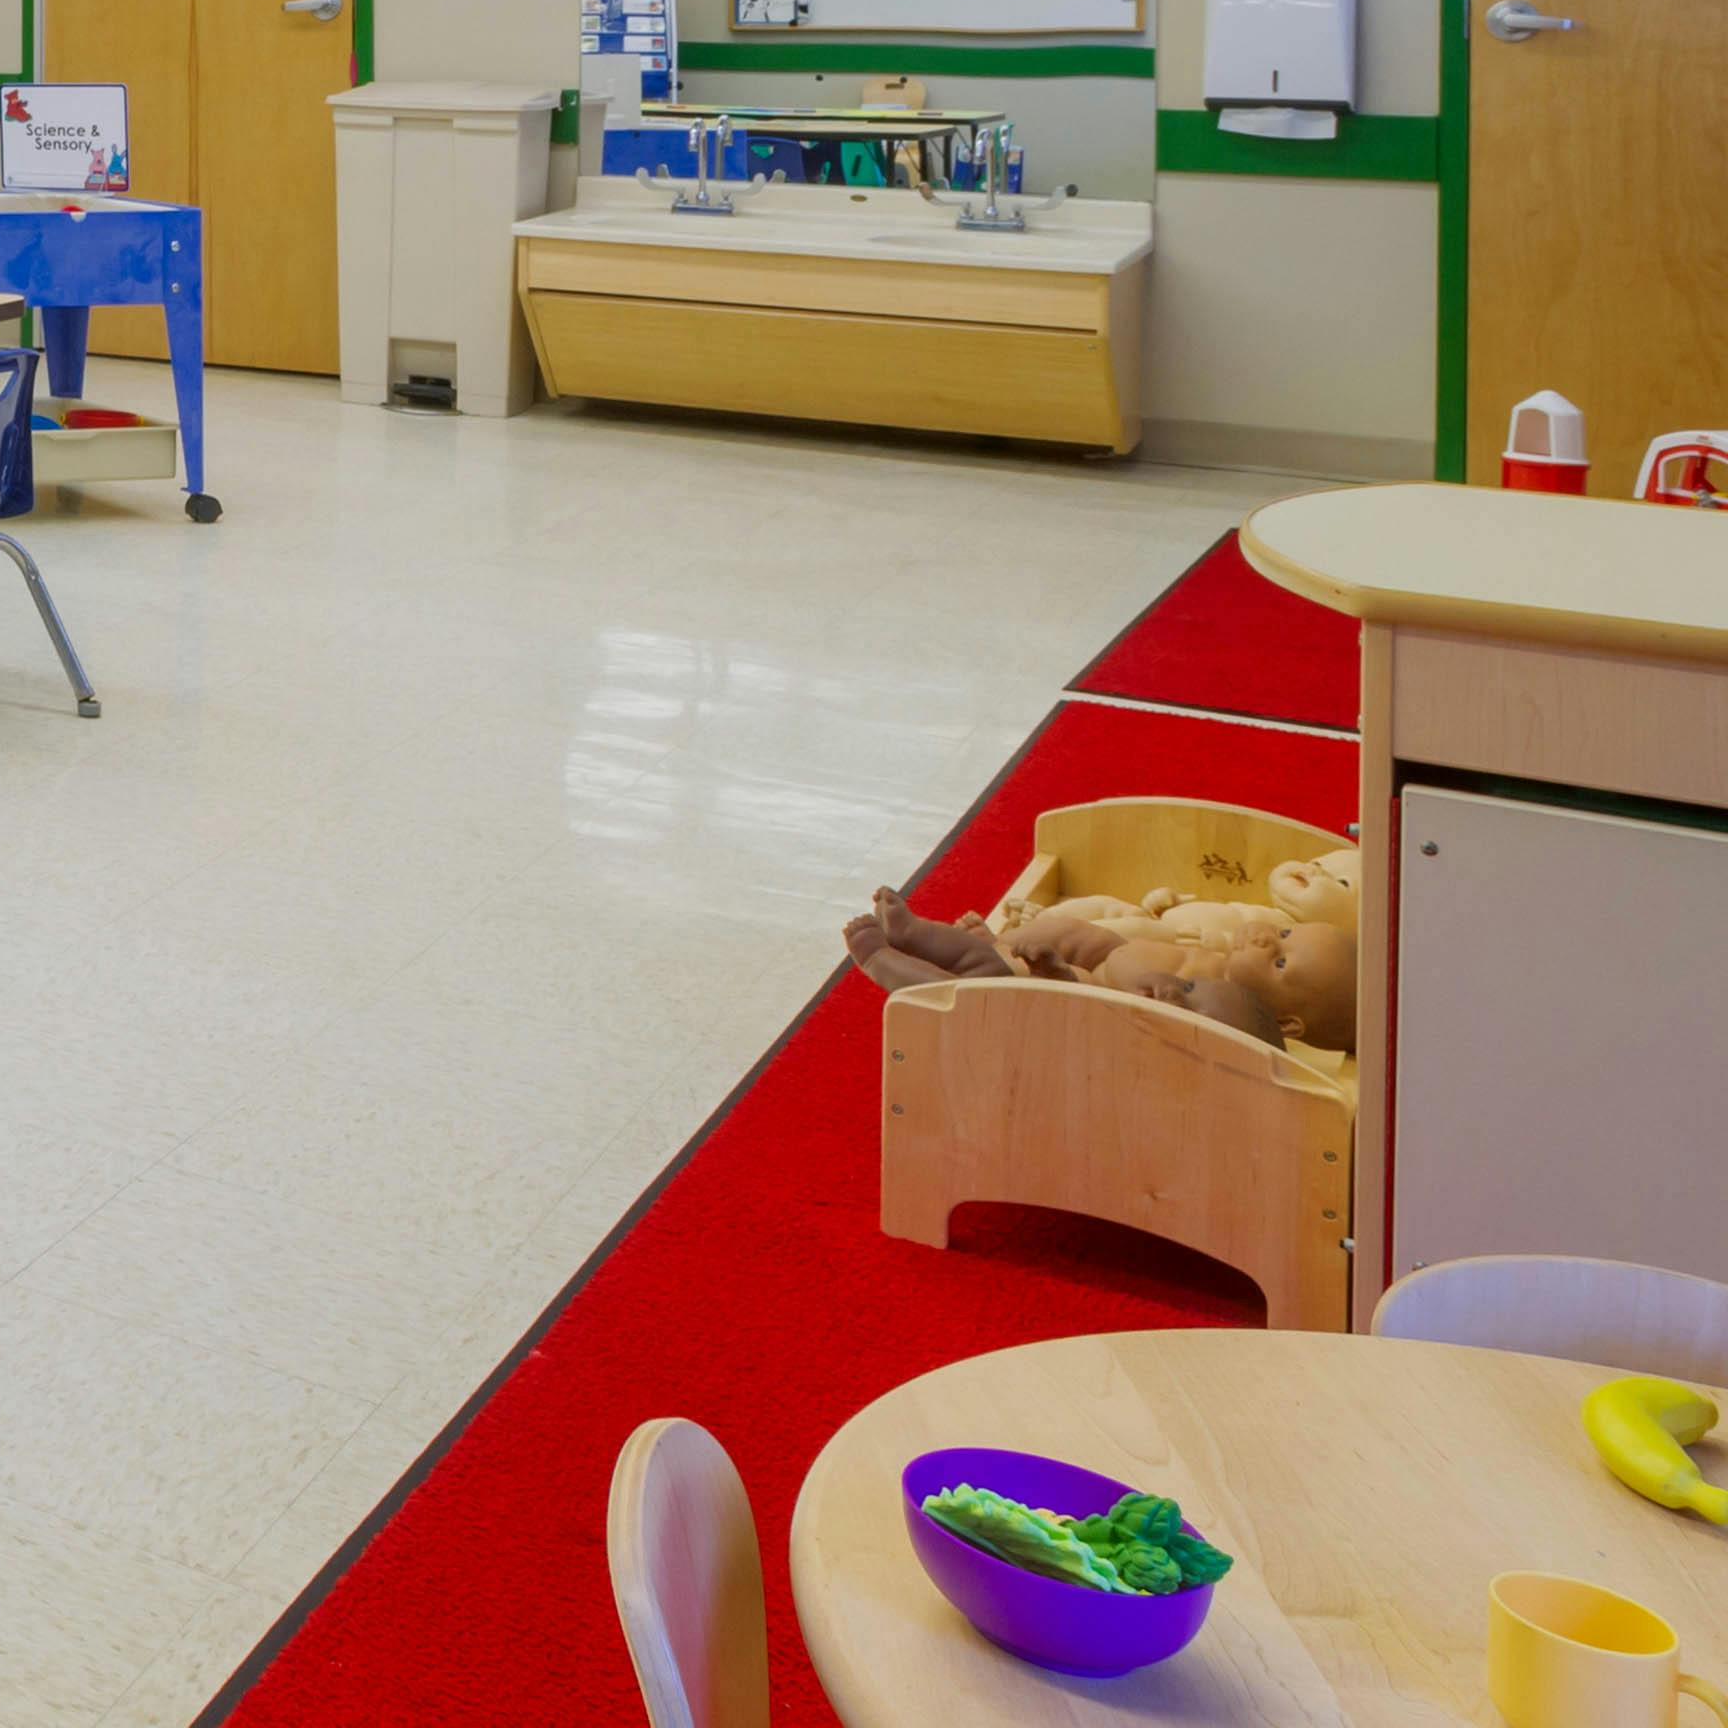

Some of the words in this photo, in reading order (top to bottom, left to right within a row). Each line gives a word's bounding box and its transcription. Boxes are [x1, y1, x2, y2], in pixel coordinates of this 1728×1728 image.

[26, 123, 86, 137] Science
[91, 124, 101, 137] &
[35, 137, 92, 154] Sensory
